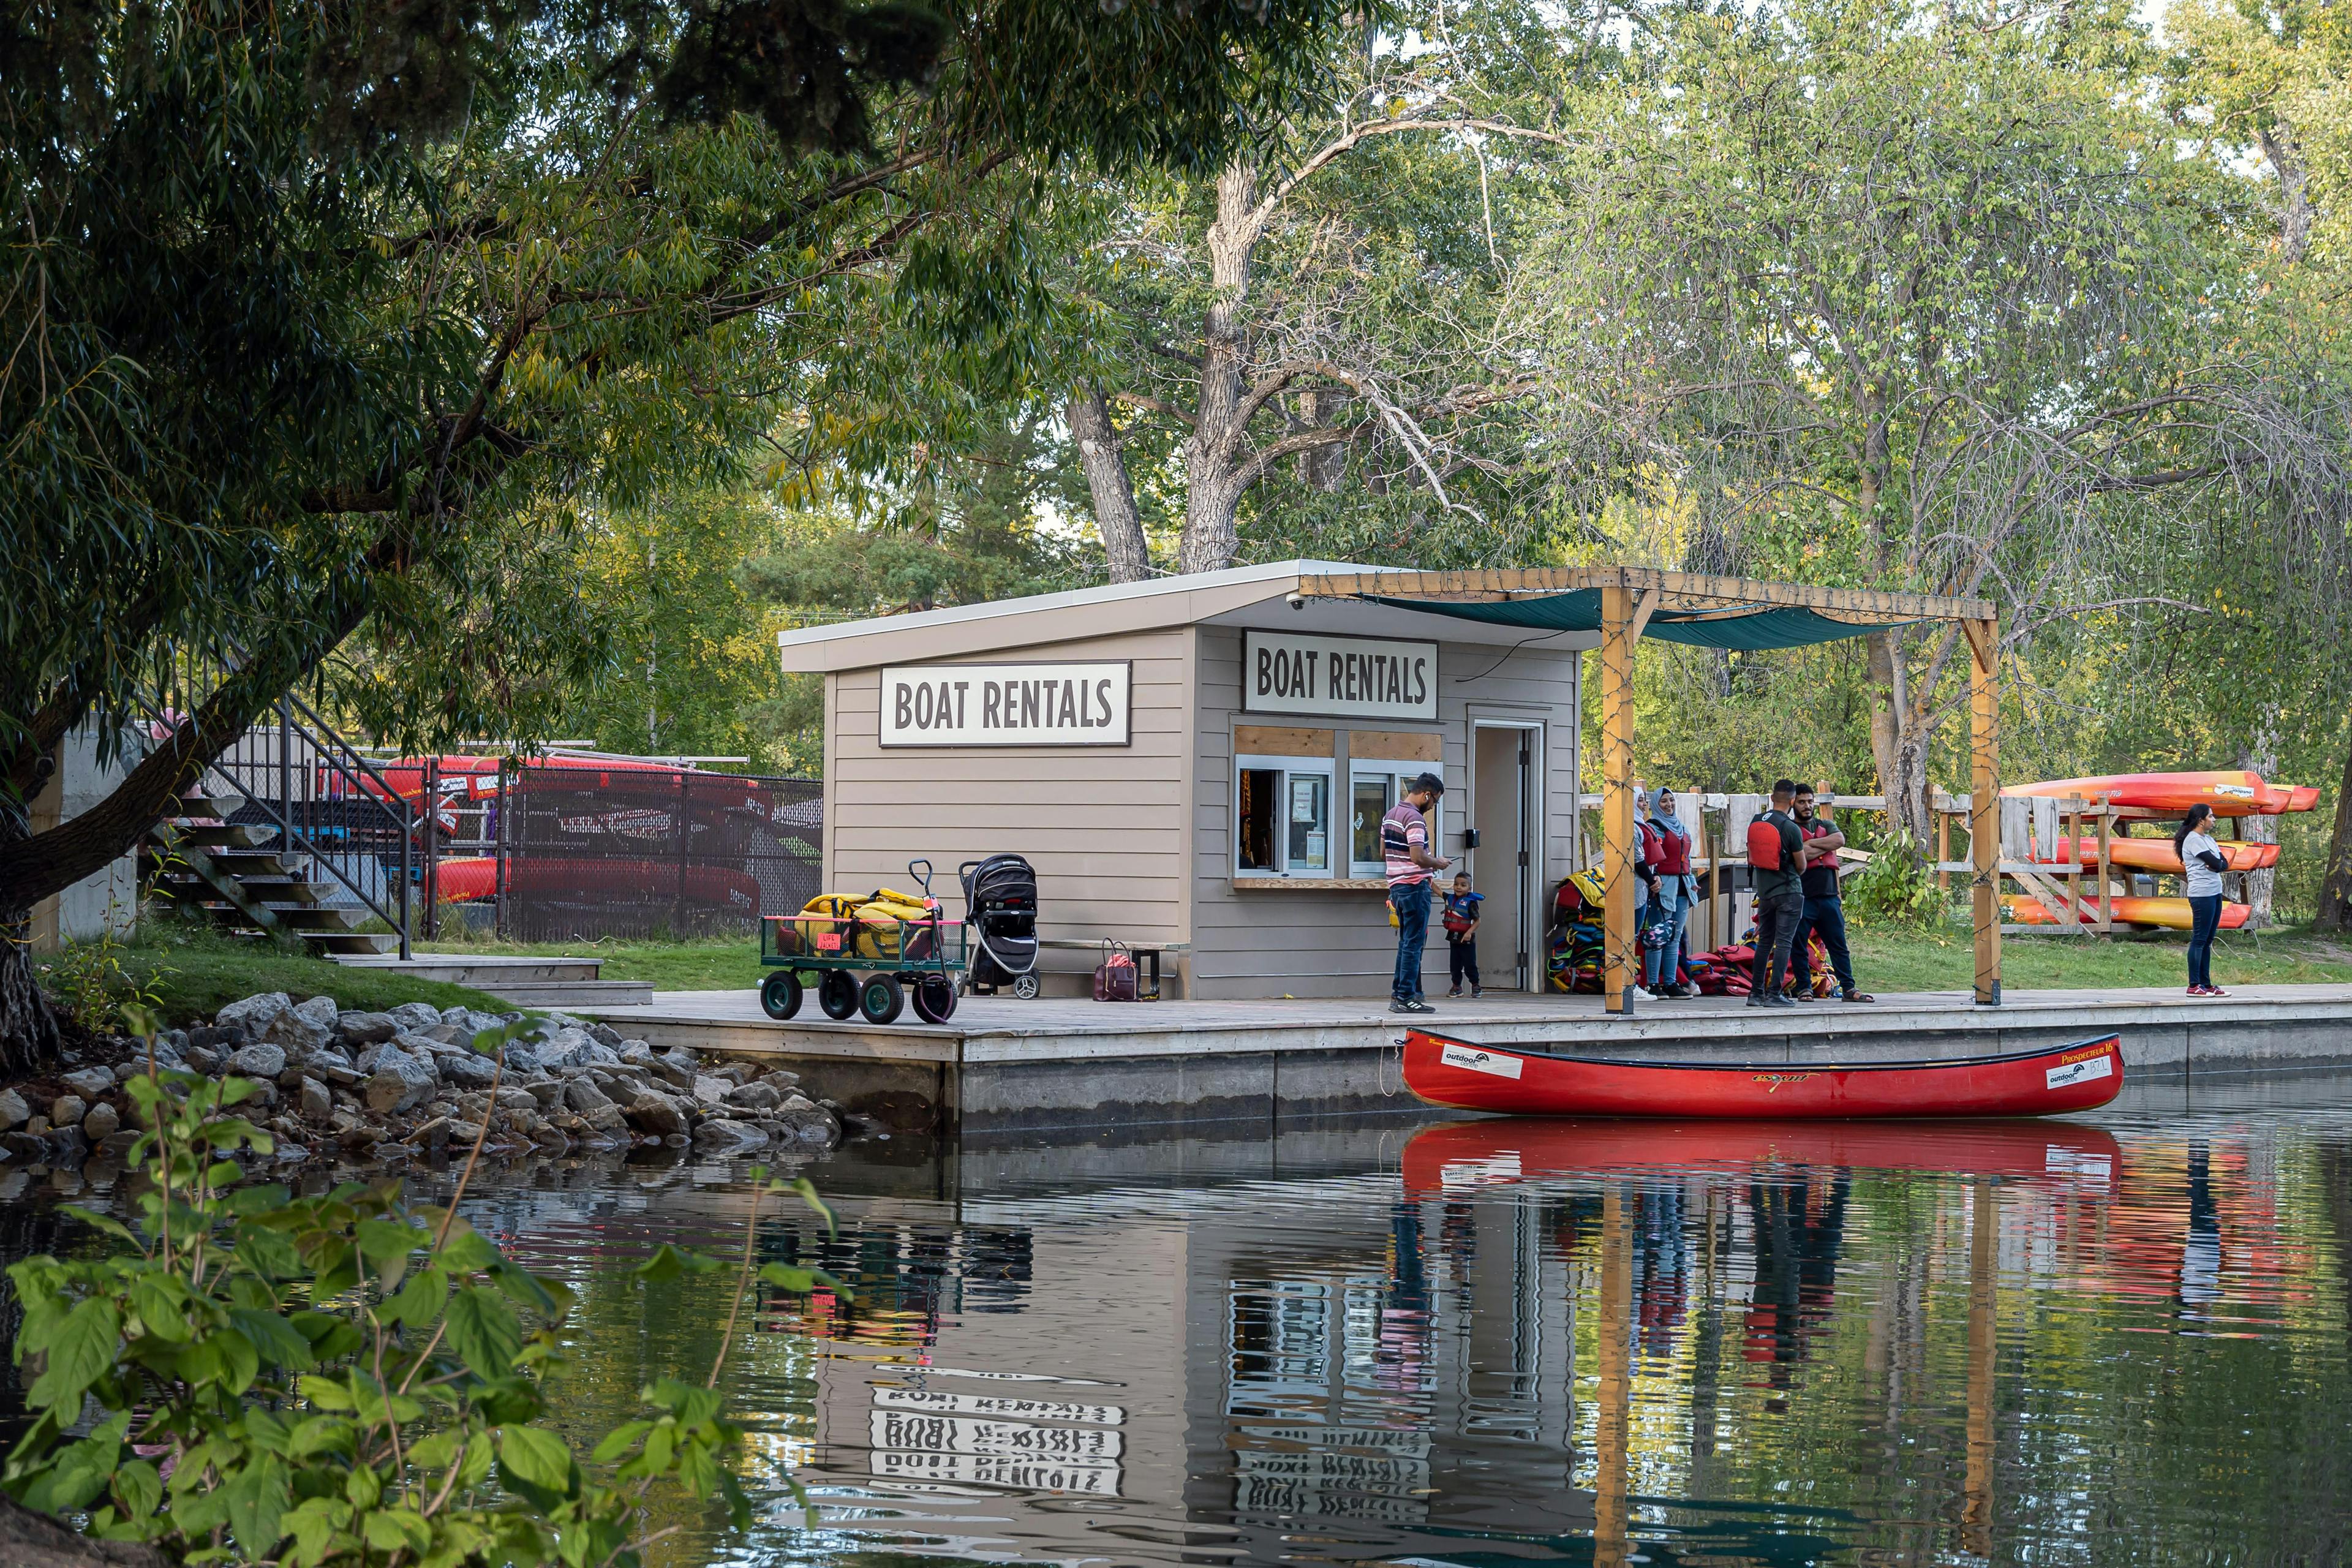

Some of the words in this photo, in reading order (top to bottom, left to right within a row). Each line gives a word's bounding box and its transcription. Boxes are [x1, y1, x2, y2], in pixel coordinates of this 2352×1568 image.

[1257, 647, 1318, 698] BOAT
[1329, 651, 1427, 704] RENTALS
[895, 681, 969, 729] BOAT
[983, 679, 1112, 729] RENTALS
[1446, 1053, 1477, 1064] outdoor
[2062, 1047, 2105, 1065] PROSPECTEUR
[2105, 1042, 2113, 1053] 16
[2050, 1072, 2076, 1083] outdoor
